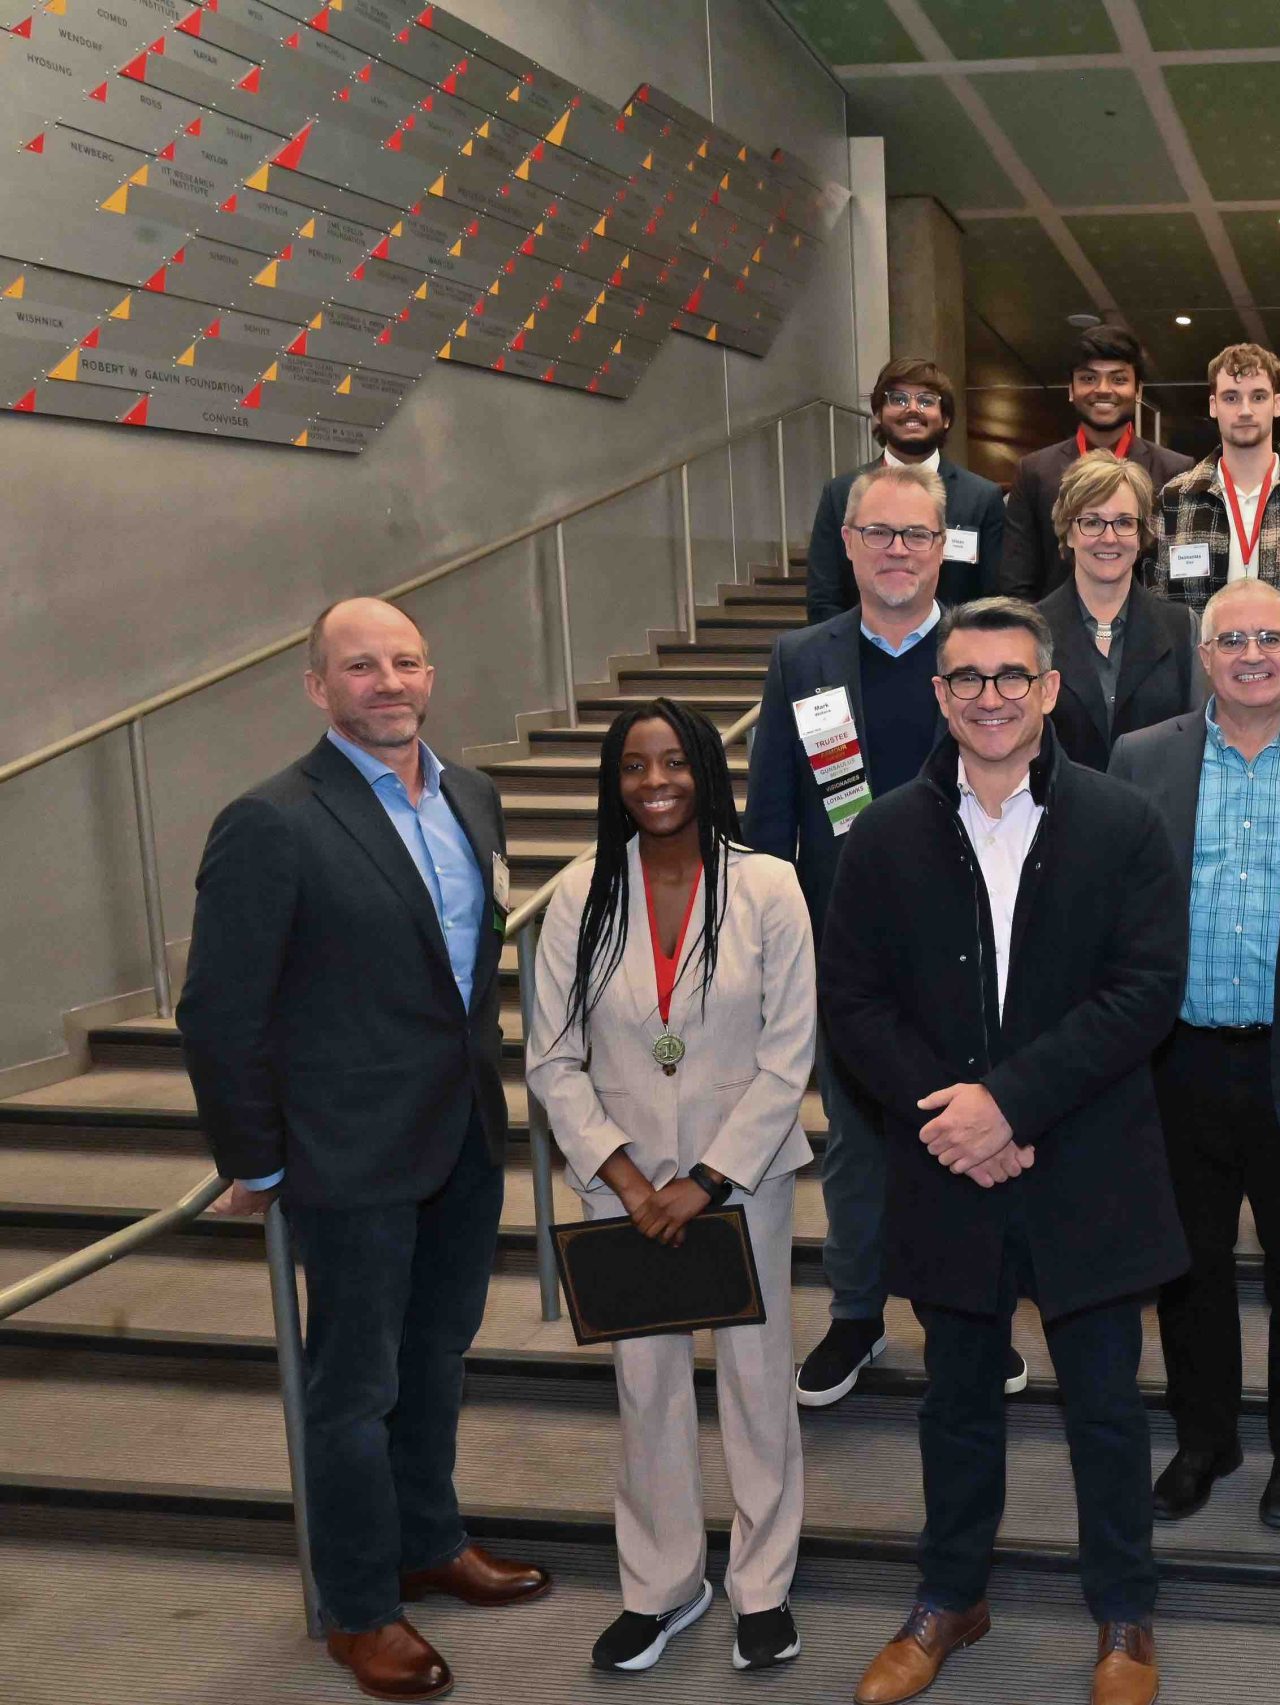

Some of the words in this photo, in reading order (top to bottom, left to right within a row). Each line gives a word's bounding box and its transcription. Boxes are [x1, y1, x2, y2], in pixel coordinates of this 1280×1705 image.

[97, 8, 128, 27] COMED
[26, 52, 72, 76] HYOSUNG
[70, 141, 115, 162] NEWBERG
[169, 178, 209, 197] INSTITUTE
[174, 169, 215, 190] RESEARCH
[16, 312, 64, 329] WISHNICK
[81, 358, 124, 375] ROBERT
[145, 369, 181, 385] GALVIN
[184, 376, 244, 394] FOUNDATION
[203, 411, 249, 427] CONVISER
[814, 702, 830, 712] Mark
[814, 732, 849, 749] TRUSTEE
[826, 793, 845, 806] LOYAL
[845, 786, 865, 799] HAWKS
